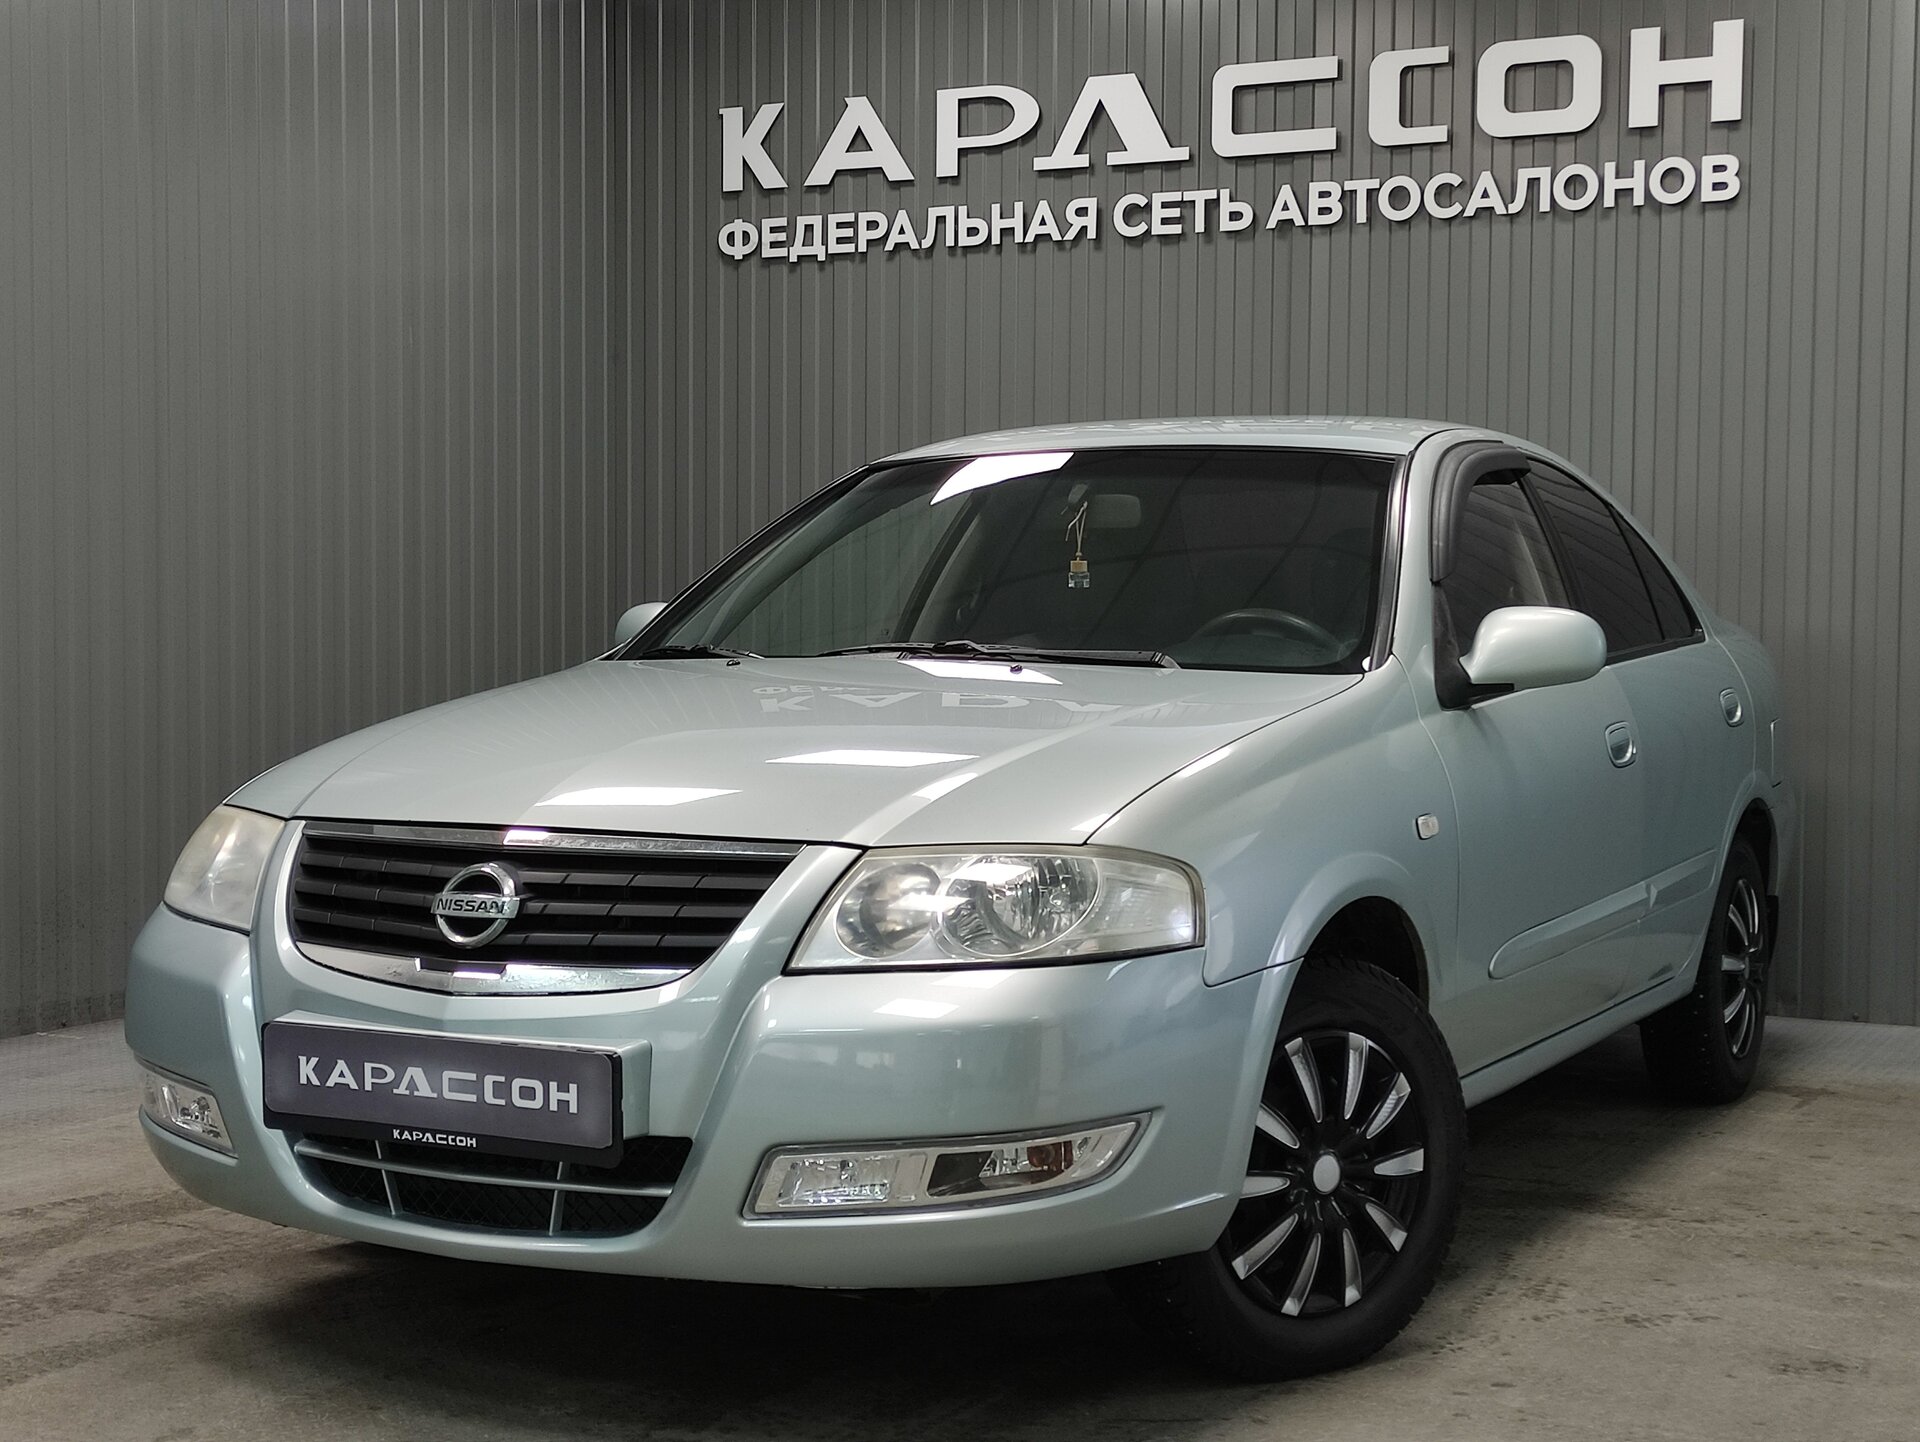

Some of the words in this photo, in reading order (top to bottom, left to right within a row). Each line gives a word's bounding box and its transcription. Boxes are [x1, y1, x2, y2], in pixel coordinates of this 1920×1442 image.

[718, 18, 1745, 192] КАРАССОН
[717, 196, 1098, 262] ФЕДЕРАЛЬНАЯ
[1112, 188, 1254, 237] СЕТЬ
[1265, 153, 1741, 229] АВТОСАЛОНОВ
[436, 898, 506, 914] NISSAN
[298, 1055, 578, 1114] КАРАССОН
[393, 1128, 477, 1148] КАРАССОН
